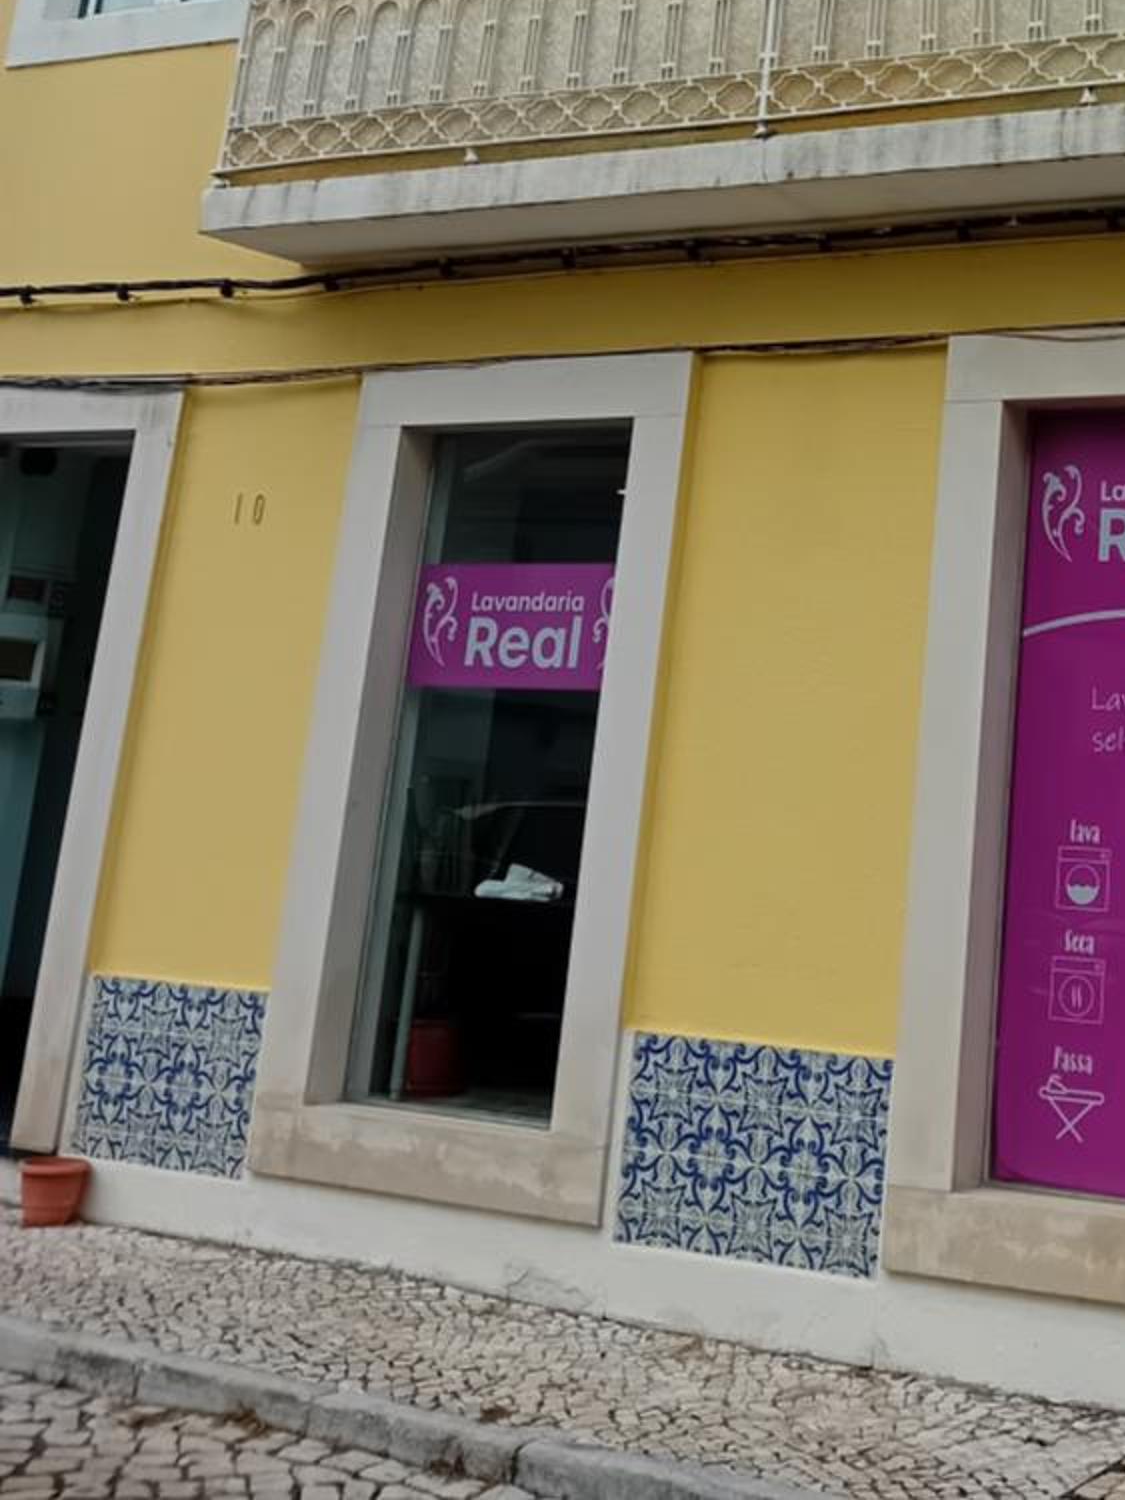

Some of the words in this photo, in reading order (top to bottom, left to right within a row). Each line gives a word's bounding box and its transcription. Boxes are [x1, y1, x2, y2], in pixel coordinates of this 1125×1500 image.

[471, 590, 585, 613] Lavandaria
[464, 615, 582, 669] Real
[1064, 928, 1094, 954] Seca
[1053, 1045, 1093, 1074] Passa
